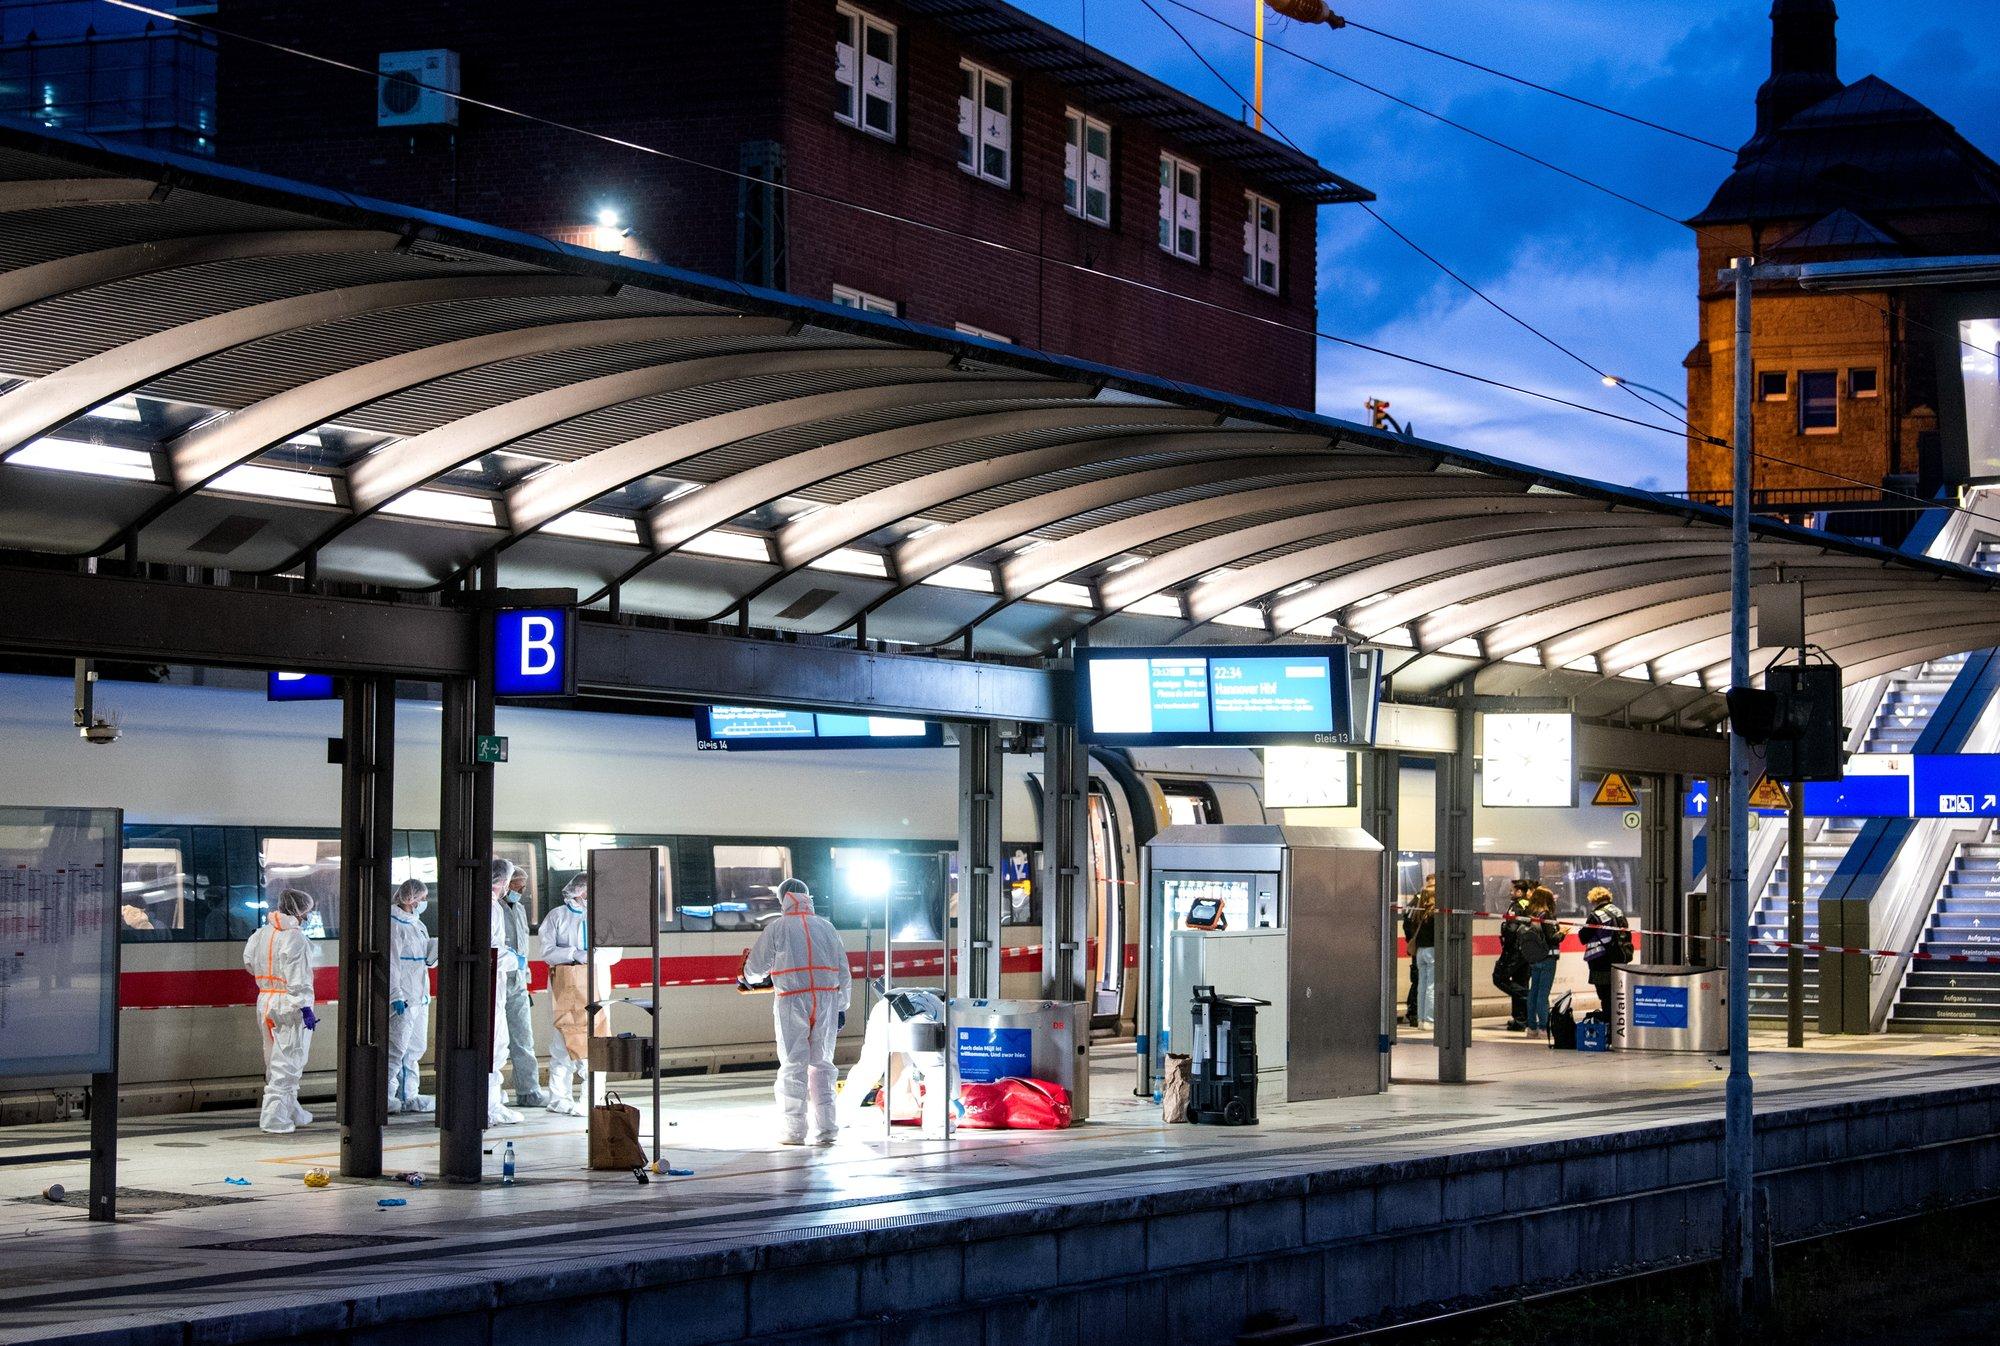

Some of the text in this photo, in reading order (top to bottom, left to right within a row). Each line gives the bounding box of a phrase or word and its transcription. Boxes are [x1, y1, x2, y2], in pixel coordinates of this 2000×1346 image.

[520, 616, 556, 676] B
[1214, 666, 1242, 679] 22:34
[1314, 733, 1349, 743] Gleis 13
[698, 740, 728, 750] Gleis 14
[1616, 992, 1625, 1038] Abfall
